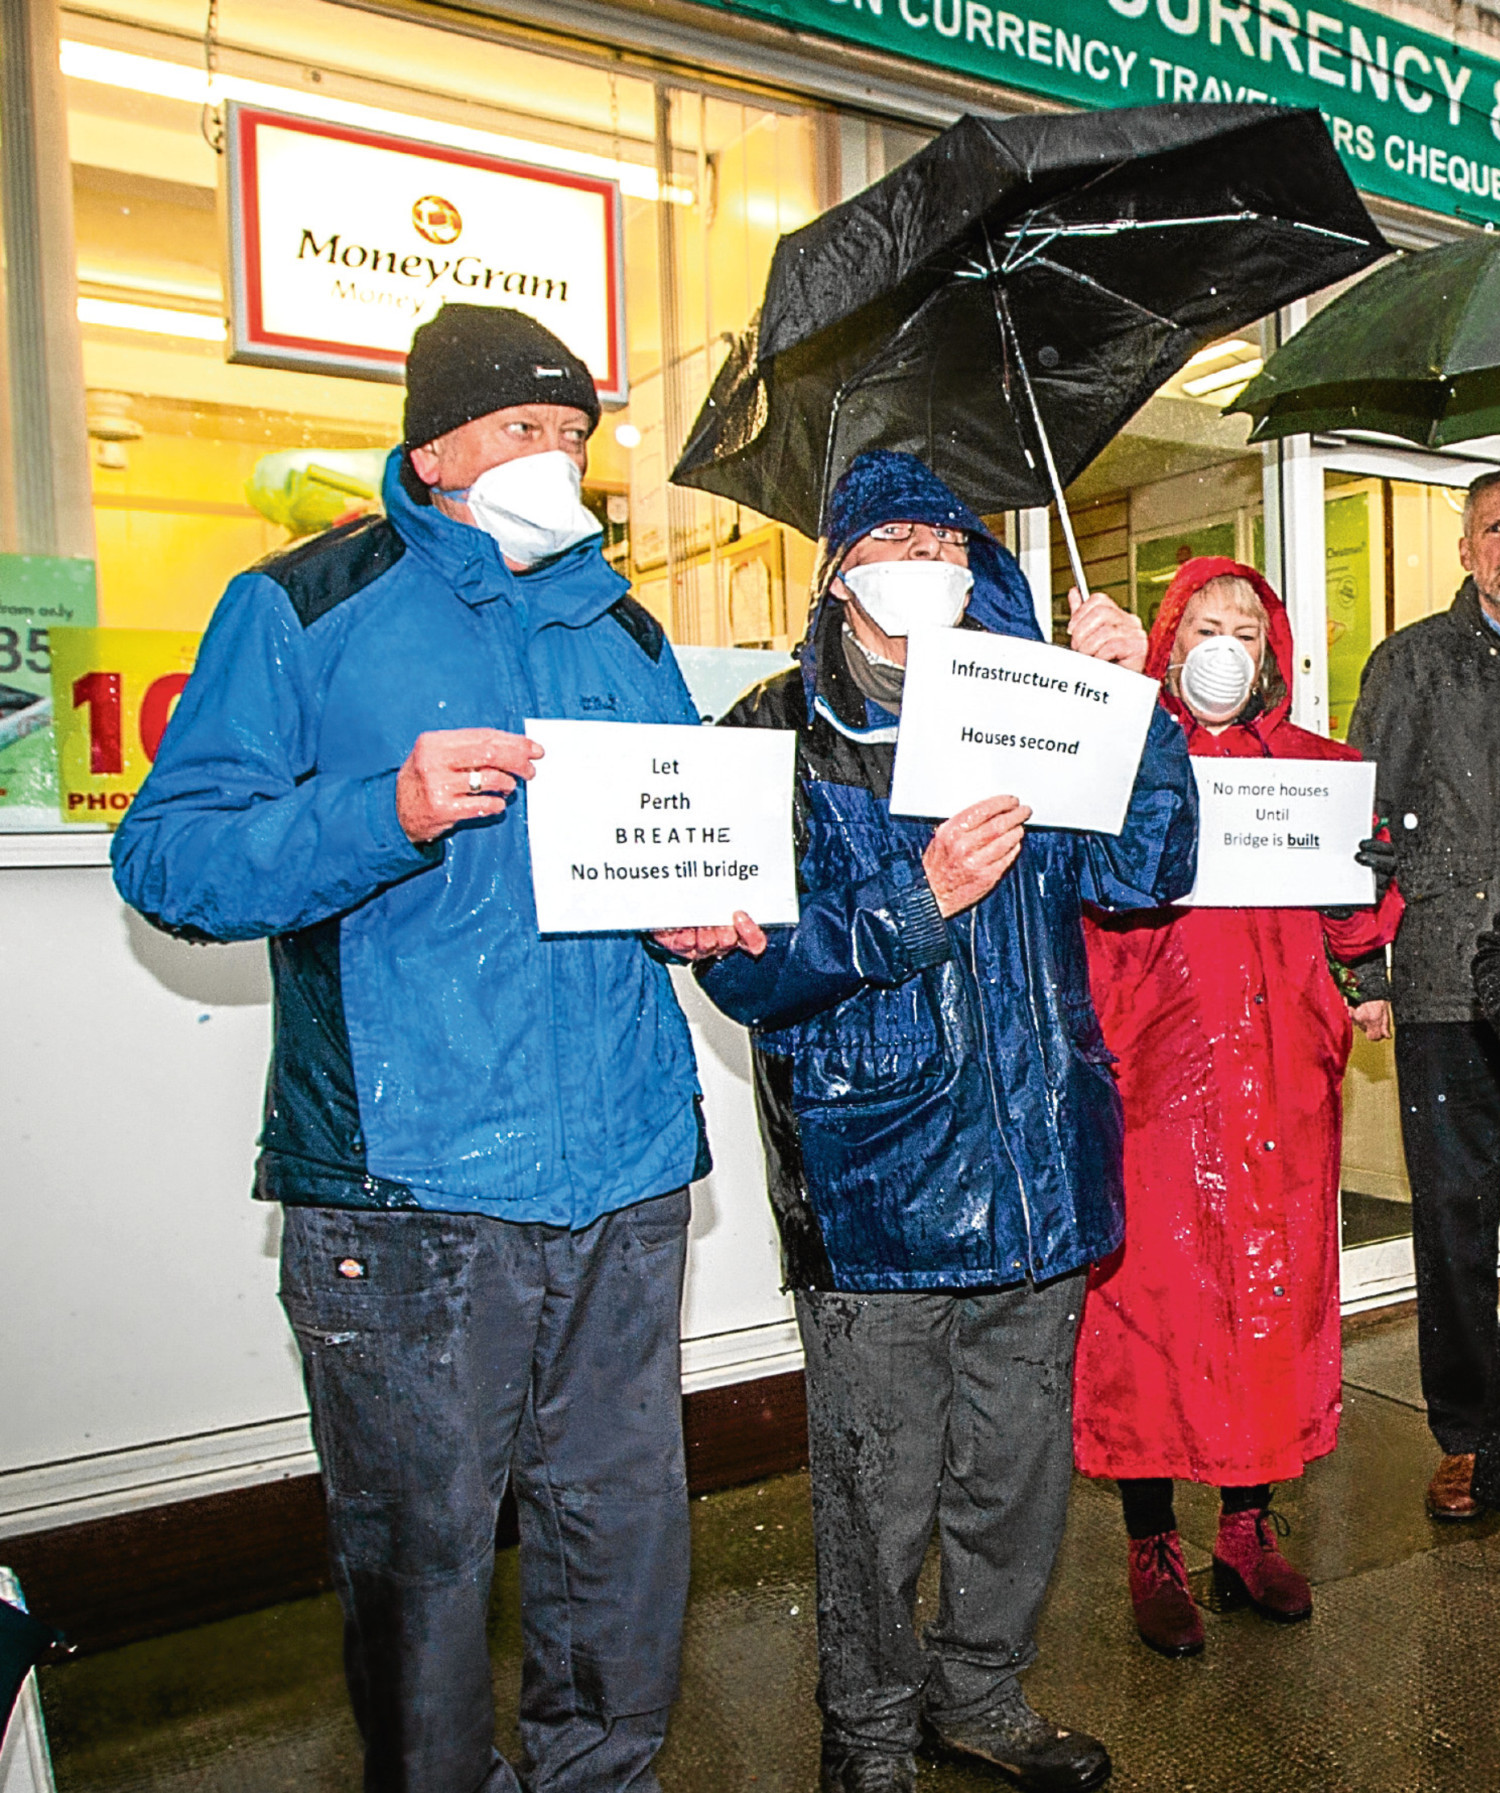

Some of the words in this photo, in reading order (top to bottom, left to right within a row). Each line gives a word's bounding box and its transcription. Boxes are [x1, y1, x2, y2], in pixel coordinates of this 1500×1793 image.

[900, 0, 1138, 89] CURRENCY
[296, 228, 568, 302] MoneyGram
[951, 659, 1068, 693] Infrastructure
[1073, 681, 1109, 704] first
[960, 726, 1016, 747] Houses
[1019, 736, 1080, 755] second
[652, 758, 680, 775] Let
[1213, 782, 1234, 796] No
[1238, 784, 1275, 797] more
[1279, 783, 1330, 797] houses
[640, 792, 691, 810] Perth
[1255, 808, 1290, 821] Until
[1223, 832, 1269, 849] Bridge
[1272, 832, 1283, 846] is
[1287, 832, 1320, 848] built
[571, 863, 598, 880] No
[604, 862, 670, 880] houses
[675, 861, 698, 878] till
[703, 860, 759, 881] bridge
